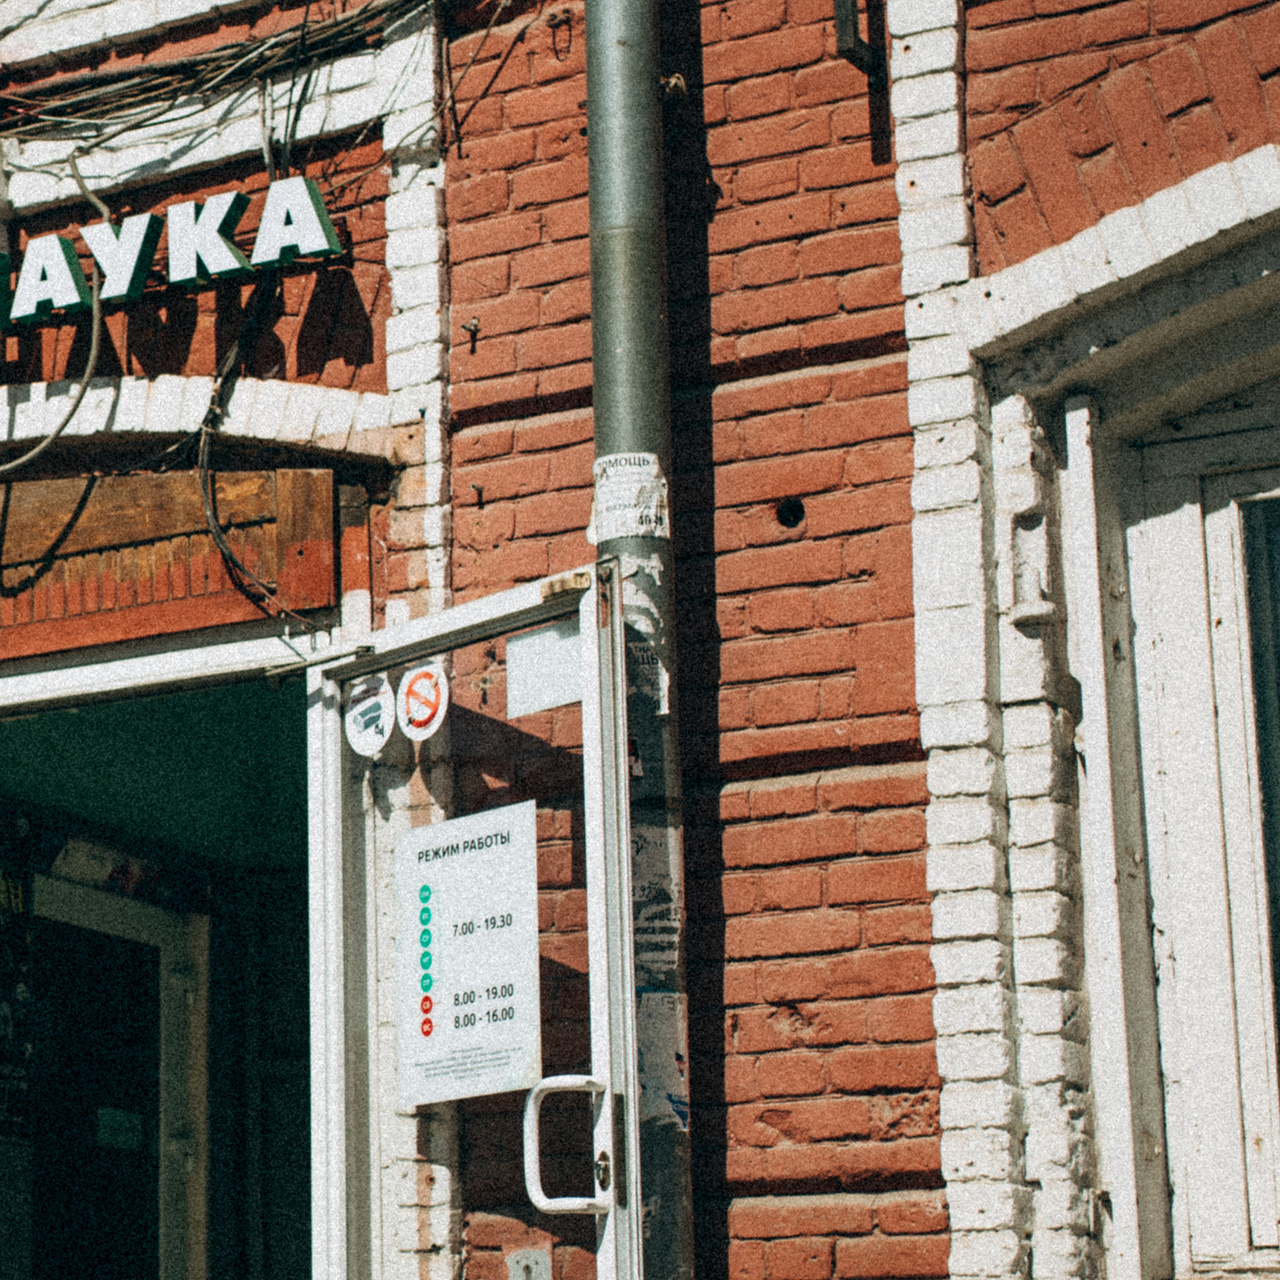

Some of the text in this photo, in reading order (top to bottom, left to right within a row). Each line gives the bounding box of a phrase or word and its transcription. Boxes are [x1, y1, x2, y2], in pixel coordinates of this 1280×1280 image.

[417, 831, 511, 864] РЕЖИМ РАБОТЫ
[453, 923, 474, 937] 7.00
[485, 914, 513, 933] 19.30
[453, 992, 475, 1007] 8.00
[485, 984, 514, 1003] 19.00
[454, 1015, 476, 1029] 8.00
[485, 1007, 515, 1024] 16.00
